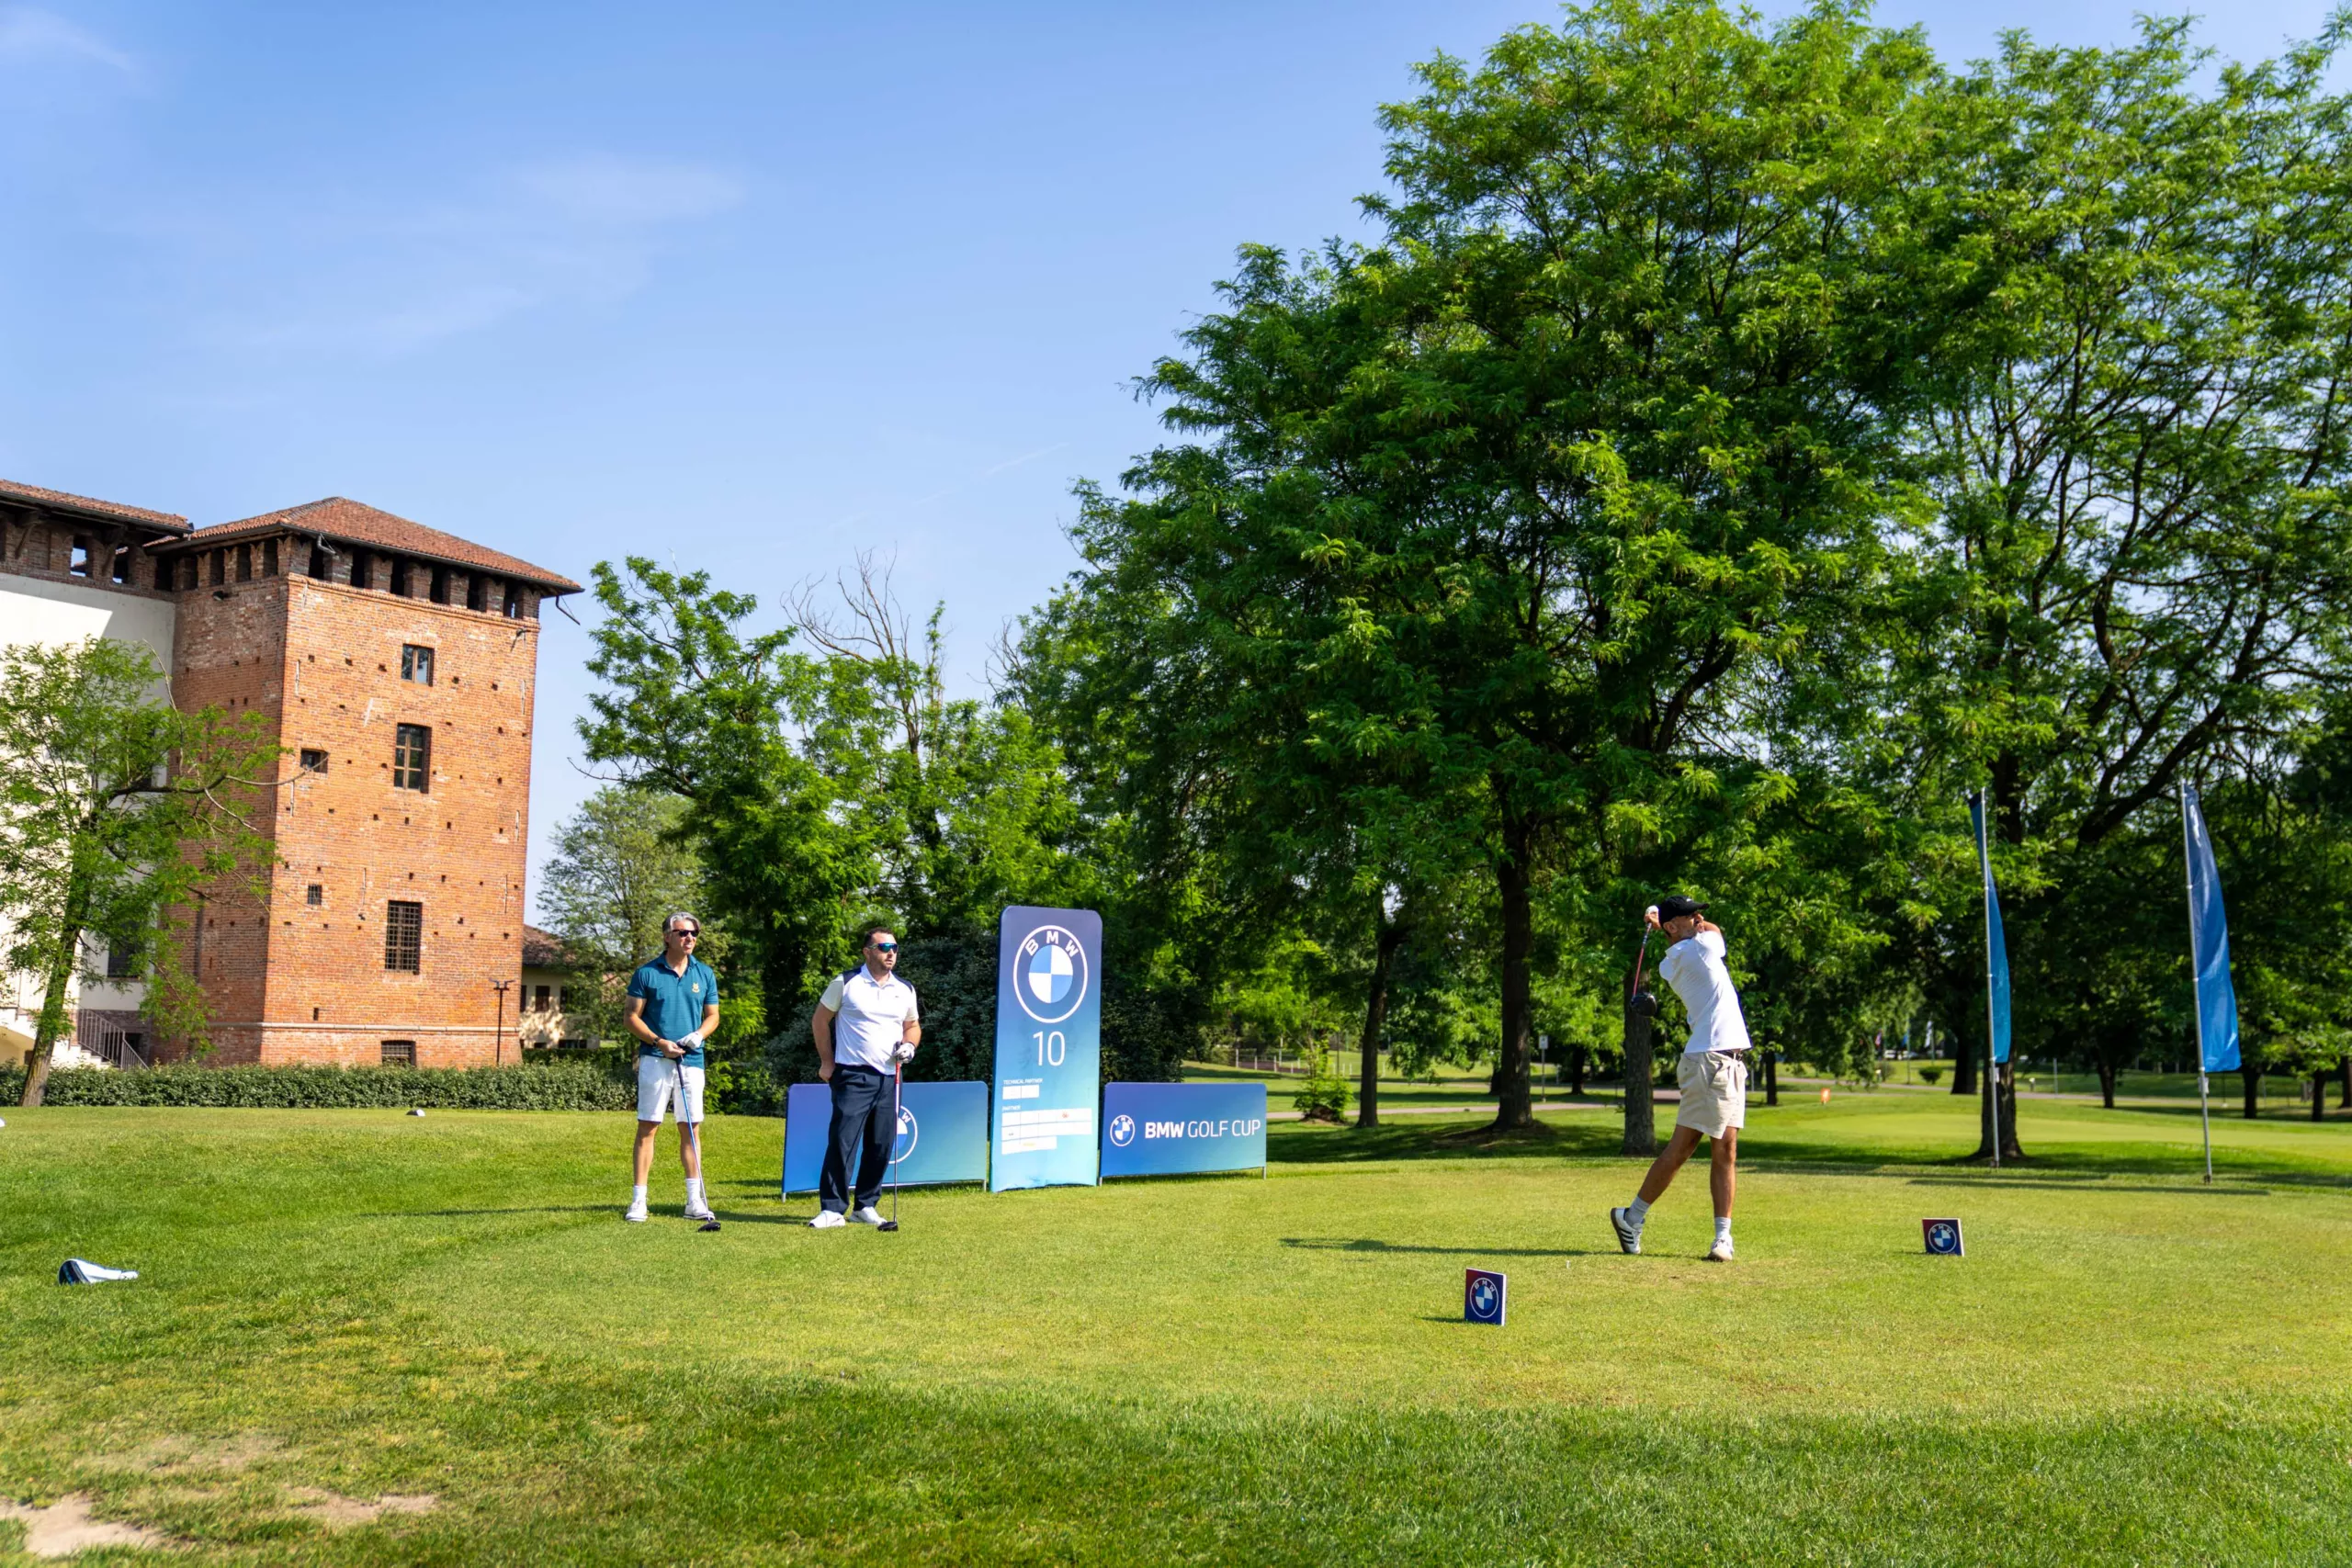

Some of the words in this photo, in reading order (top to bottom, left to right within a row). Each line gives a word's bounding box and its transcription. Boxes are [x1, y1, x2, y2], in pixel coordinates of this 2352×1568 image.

[1024, 930, 1080, 958] BMW
[1033, 1031, 1066, 1066] 10
[1145, 1122, 1184, 1138] BMW
[1188, 1121, 1228, 1138] GOLF
[1232, 1120, 1261, 1136] CUP
